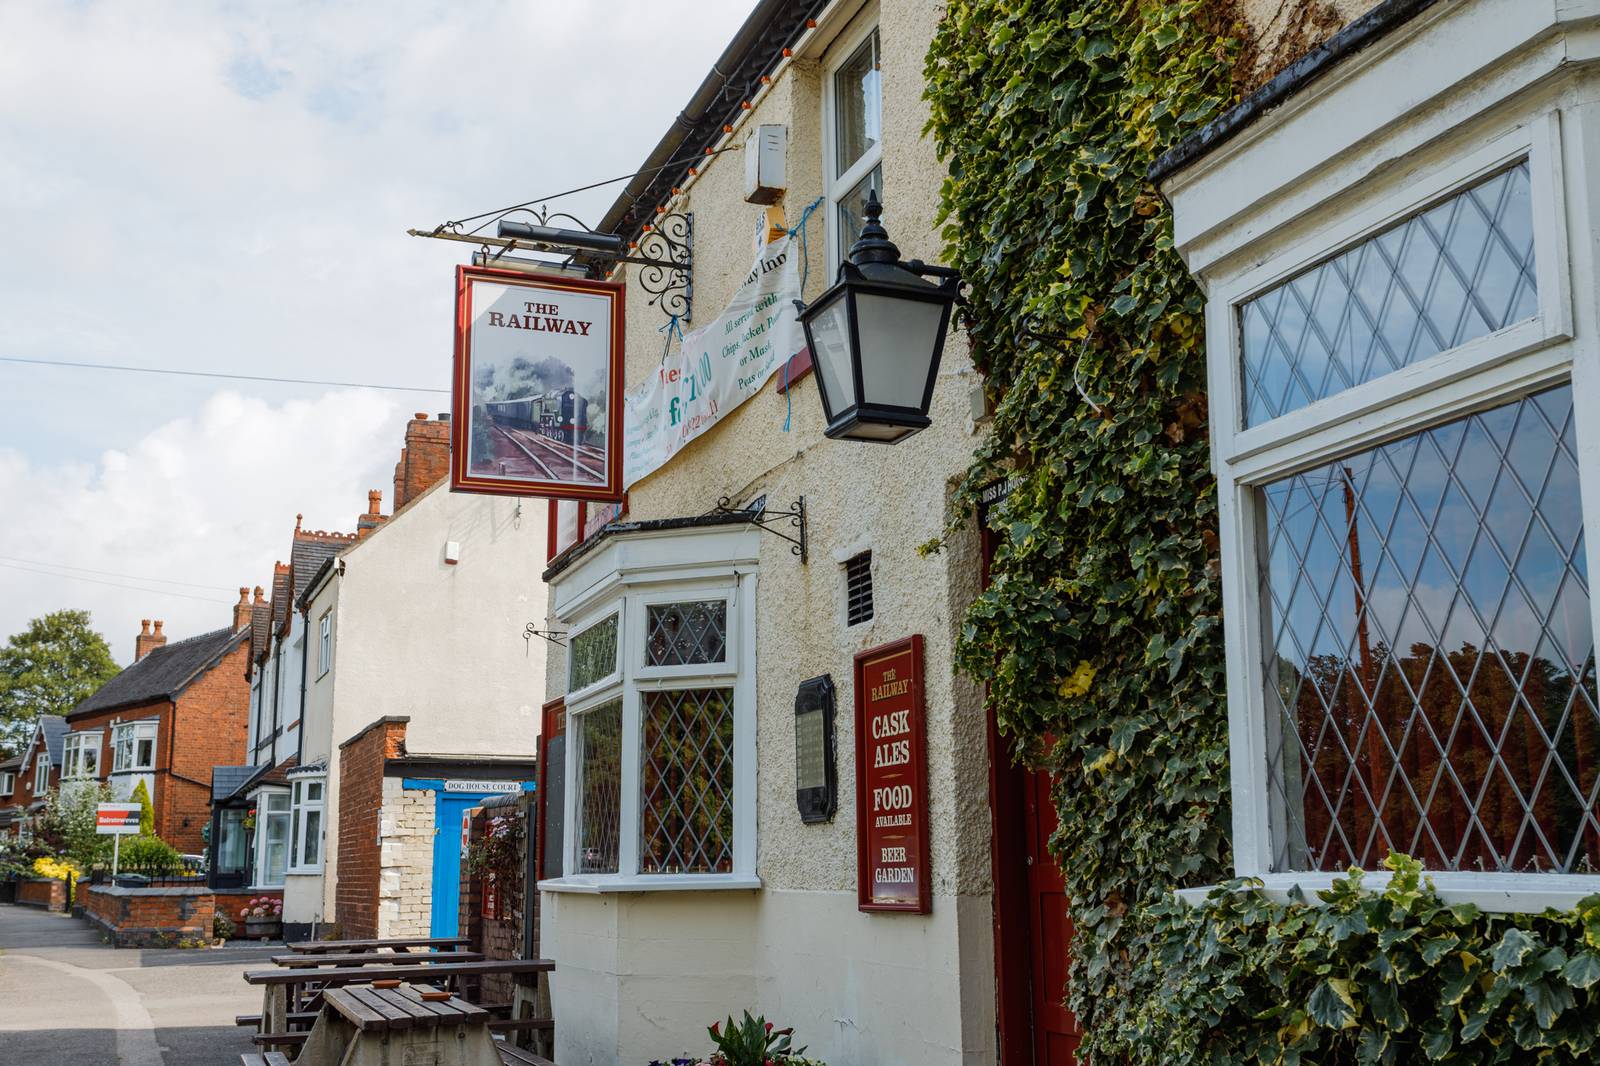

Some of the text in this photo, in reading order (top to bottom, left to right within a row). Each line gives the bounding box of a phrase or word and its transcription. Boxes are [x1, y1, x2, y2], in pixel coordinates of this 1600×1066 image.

[760, 253, 787, 274] Inn
[524, 301, 559, 316] THE
[755, 293, 777, 312] with
[488, 311, 592, 336] RAILWAY
[739, 356, 748, 367] or
[738, 374, 756, 390] Peas
[883, 668, 896, 682] THE
[871, 679, 909, 701] RAILWAY
[872, 709, 910, 739] CASK
[874, 740, 910, 768] ALES
[873, 784, 912, 812] FOOD
[875, 814, 912, 828] AVAILABLE
[881, 847, 907, 863] BEER
[875, 867, 914, 883] GARDEN
